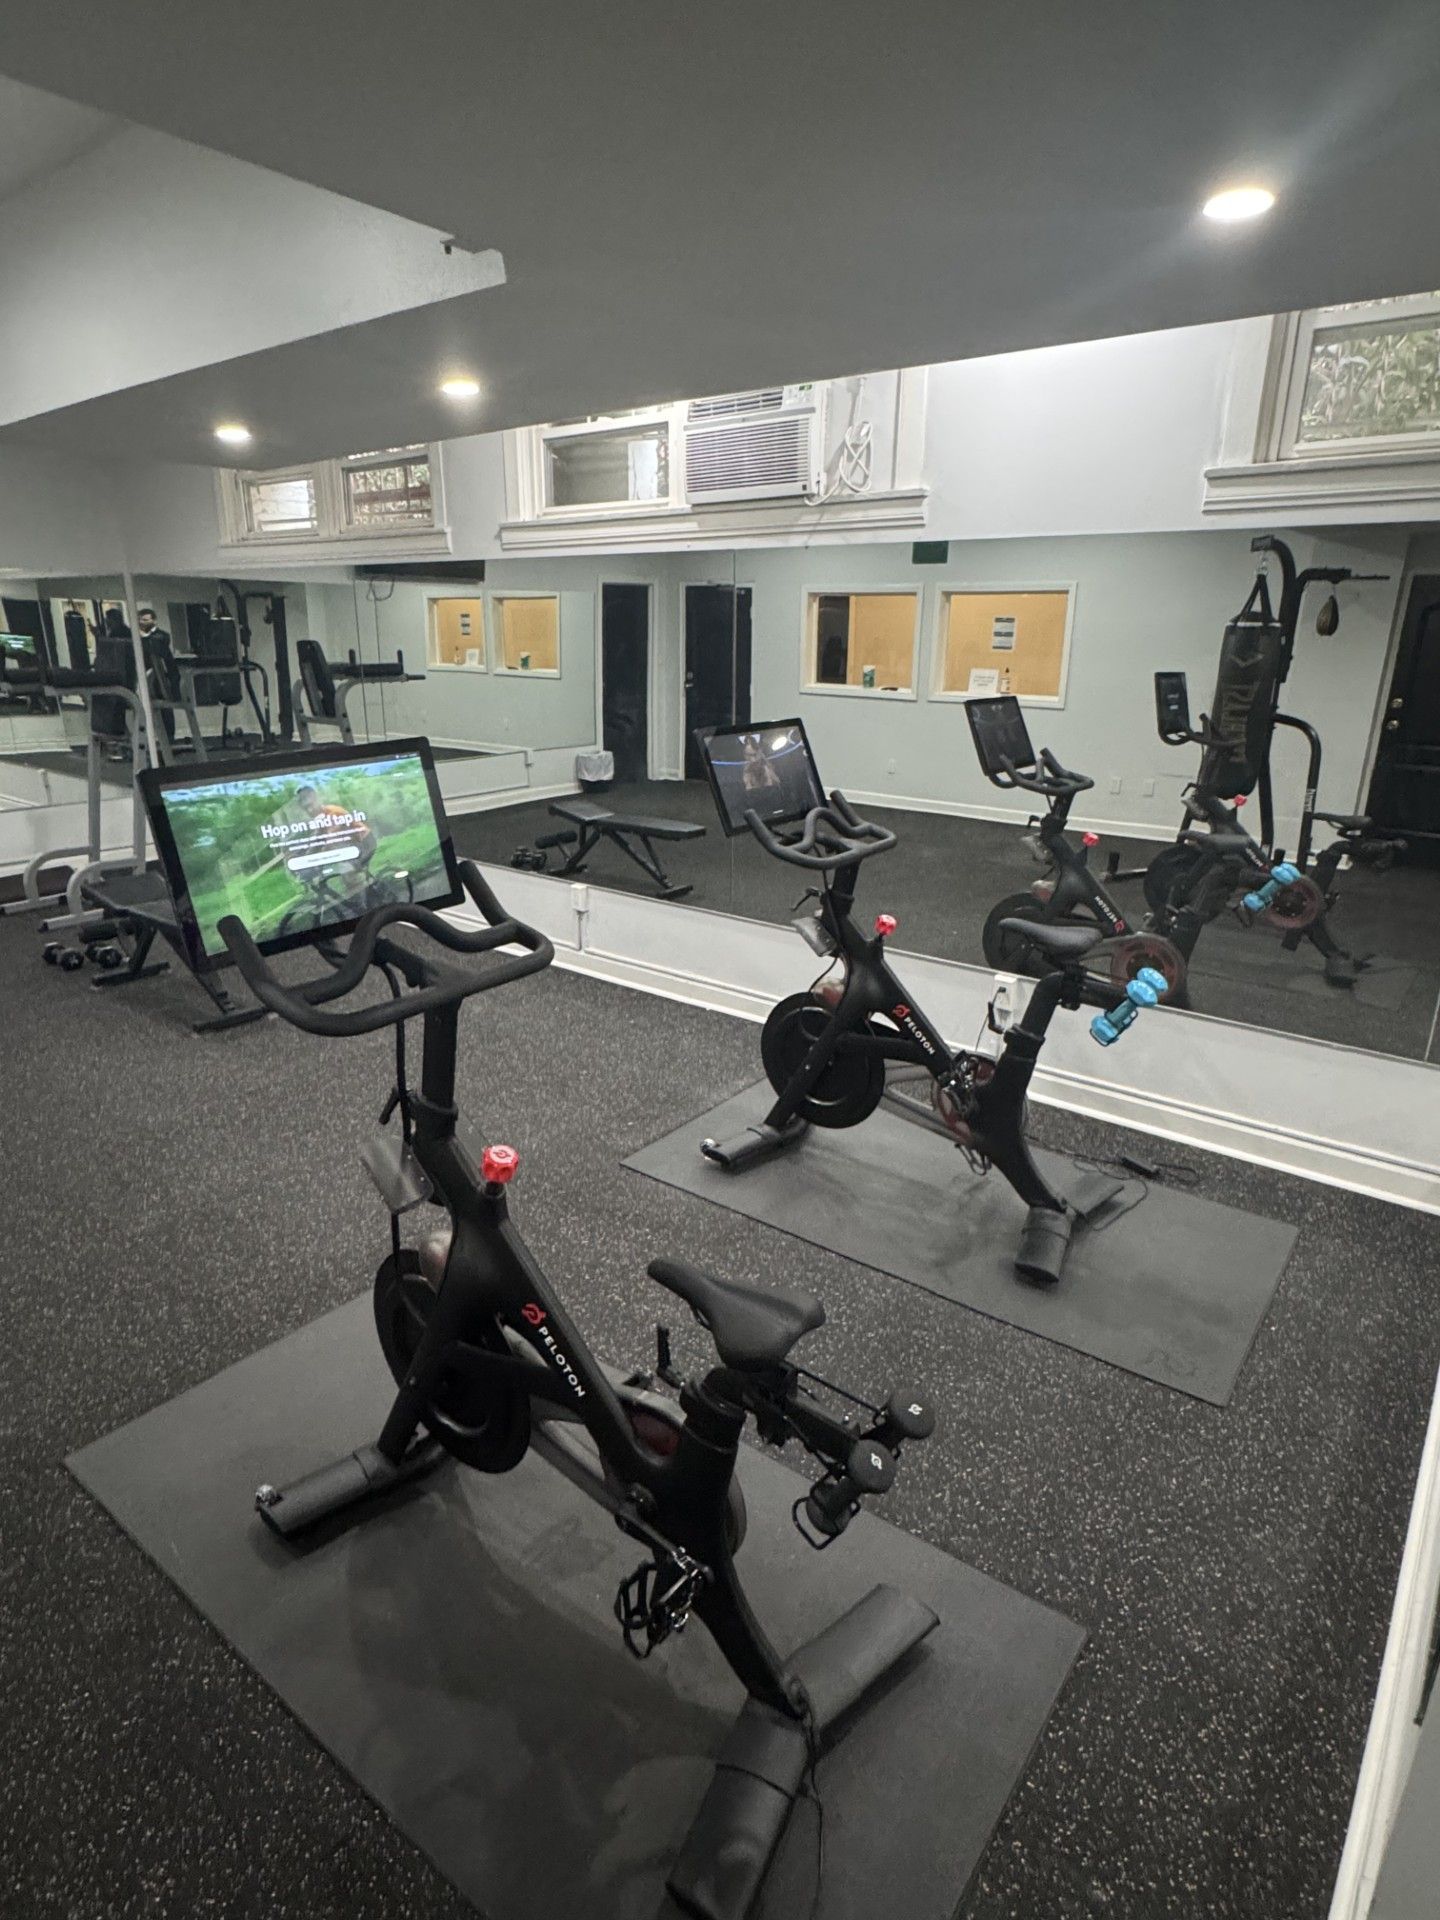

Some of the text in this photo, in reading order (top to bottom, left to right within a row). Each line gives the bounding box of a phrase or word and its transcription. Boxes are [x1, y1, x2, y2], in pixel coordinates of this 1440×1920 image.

[261, 824, 289, 838] Hop
[291, 822, 307, 833] on
[309, 815, 332, 829] and
[333, 814, 353, 826] tap
[353, 810, 366, 821] in
[904, 1016, 936, 1055] PELOTON
[538, 1326, 586, 1398] PELOTON
